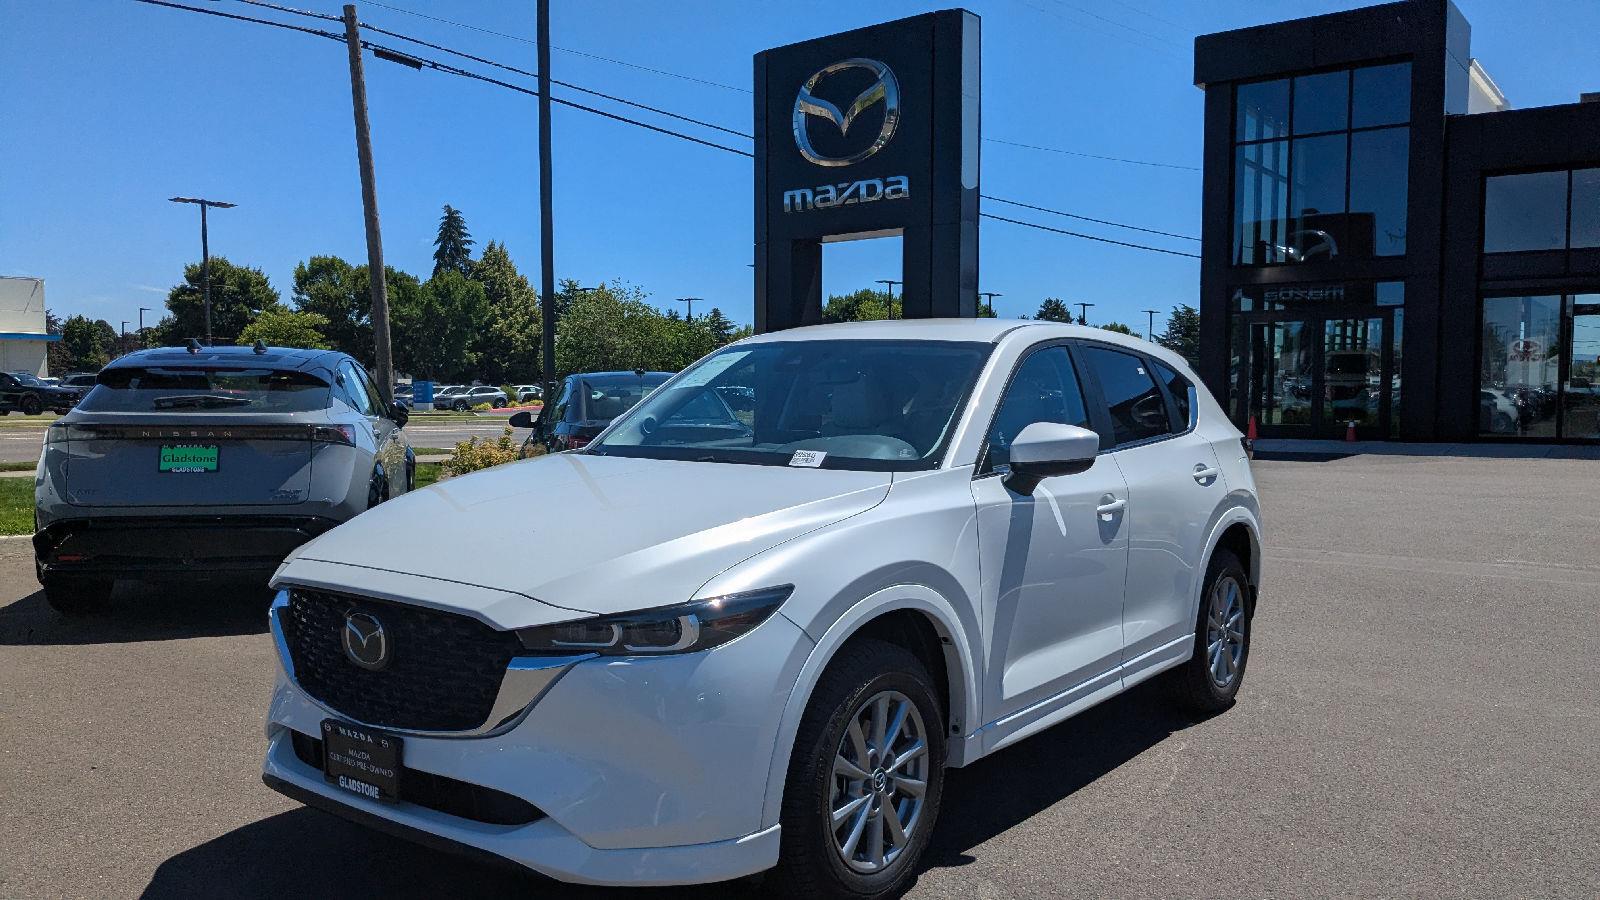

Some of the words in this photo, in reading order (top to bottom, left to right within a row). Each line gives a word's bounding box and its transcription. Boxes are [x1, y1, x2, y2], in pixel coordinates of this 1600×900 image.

[162, 453, 217, 463] Gladstone
[338, 726, 374, 744] MAZDA
[348, 747, 371, 761] MAZDA
[338, 775, 380, 799] GLADSTONE
